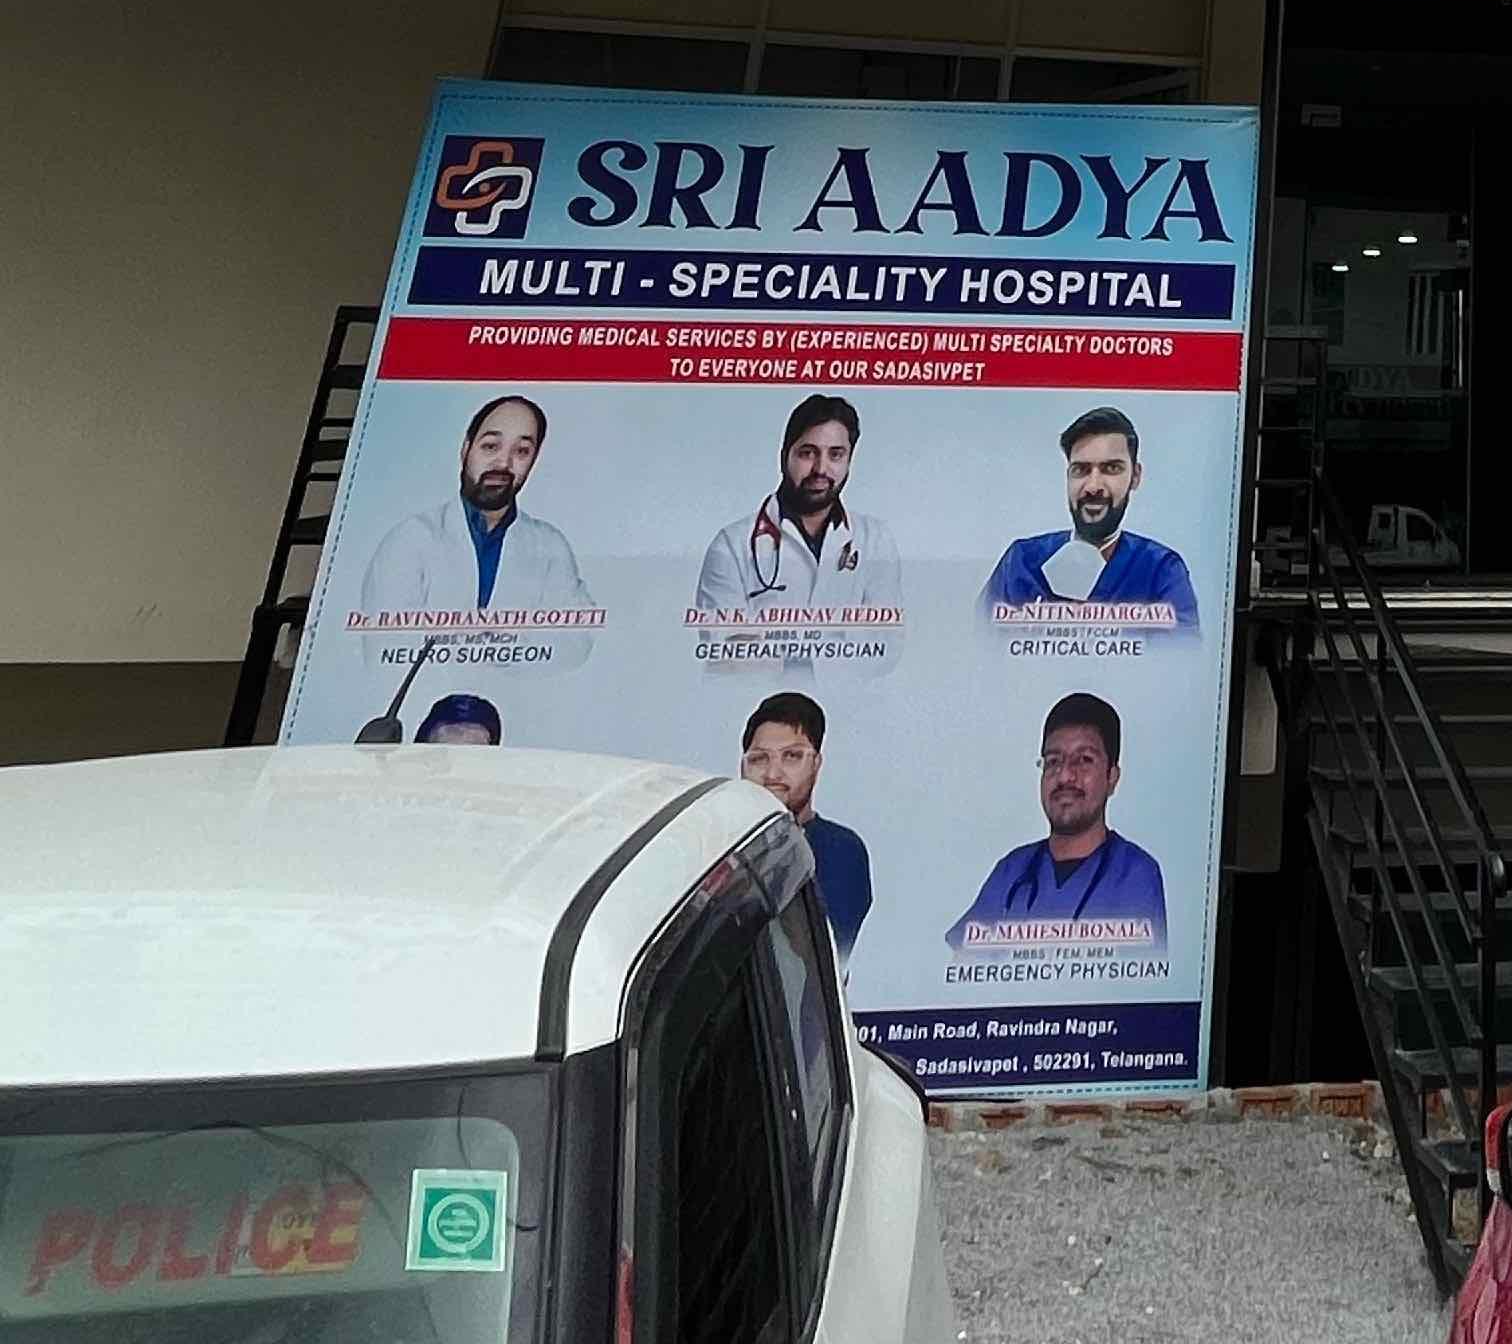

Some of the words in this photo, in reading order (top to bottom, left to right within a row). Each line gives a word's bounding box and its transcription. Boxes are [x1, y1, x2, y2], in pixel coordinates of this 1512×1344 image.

[567, 140, 776, 232] SRI
[796, 146, 1236, 243] AADYA
[479, 259, 626, 297] MULTI
[670, 262, 947, 303] SPECIALITY
[959, 267, 1183, 309] HOSPITAL
[468, 326, 573, 346] PROVIDING
[578, 327, 660, 347] MEDICAL
[665, 328, 756, 348] SERVICES
[762, 329, 787, 349] BY
[791, 330, 929, 354] (EXPERIENCED)
[933, 332, 984, 353] MULTI
[990, 333, 1086, 354] SPECIALTY
[1090, 335, 1174, 356] DOCTORS
[670, 358, 694, 377] TO
[699, 358, 797, 379] EVERYONE
[800, 360, 825, 379] AT
[829, 361, 867, 380] OUR
[872, 361, 985, 382] SADASIVPET
[378, 610, 526, 627] RAVINDRANATH
[532, 609, 606, 626] GOTETI
[755, 608, 836, 623] ABHINAV
[841, 608, 904, 623] REDDY
[1025, 605, 1077, 620] NITIN
[1081, 606, 1174, 621] BHARGAVA
[381, 647, 450, 664] NEURO
[456, 646, 552, 663] SURGEON
[695, 643, 783, 659] GENERAL
[788, 643, 885, 658] PHYSICIAN
[1010, 641, 1089, 656] CRITICAL
[1095, 641, 1143, 655] CARE
[996, 923, 1074, 939] MAHESH
[1080, 923, 1150, 938] BONALA
[946, 963, 1064, 983] EMERGENCY
[1071, 961, 1169, 980] PHYSICIAN
[853, 1026, 882, 1044] 01,
[888, 1024, 928, 1041] Main
[933, 1022, 980, 1040] Road,
[987, 1019, 1060, 1037] Ravindra
[1065, 1019, 1118, 1037] Nagar,
[1101, 1051, 1188, 1070] Telangana.
[21, 1181, 370, 1297] POLICE
